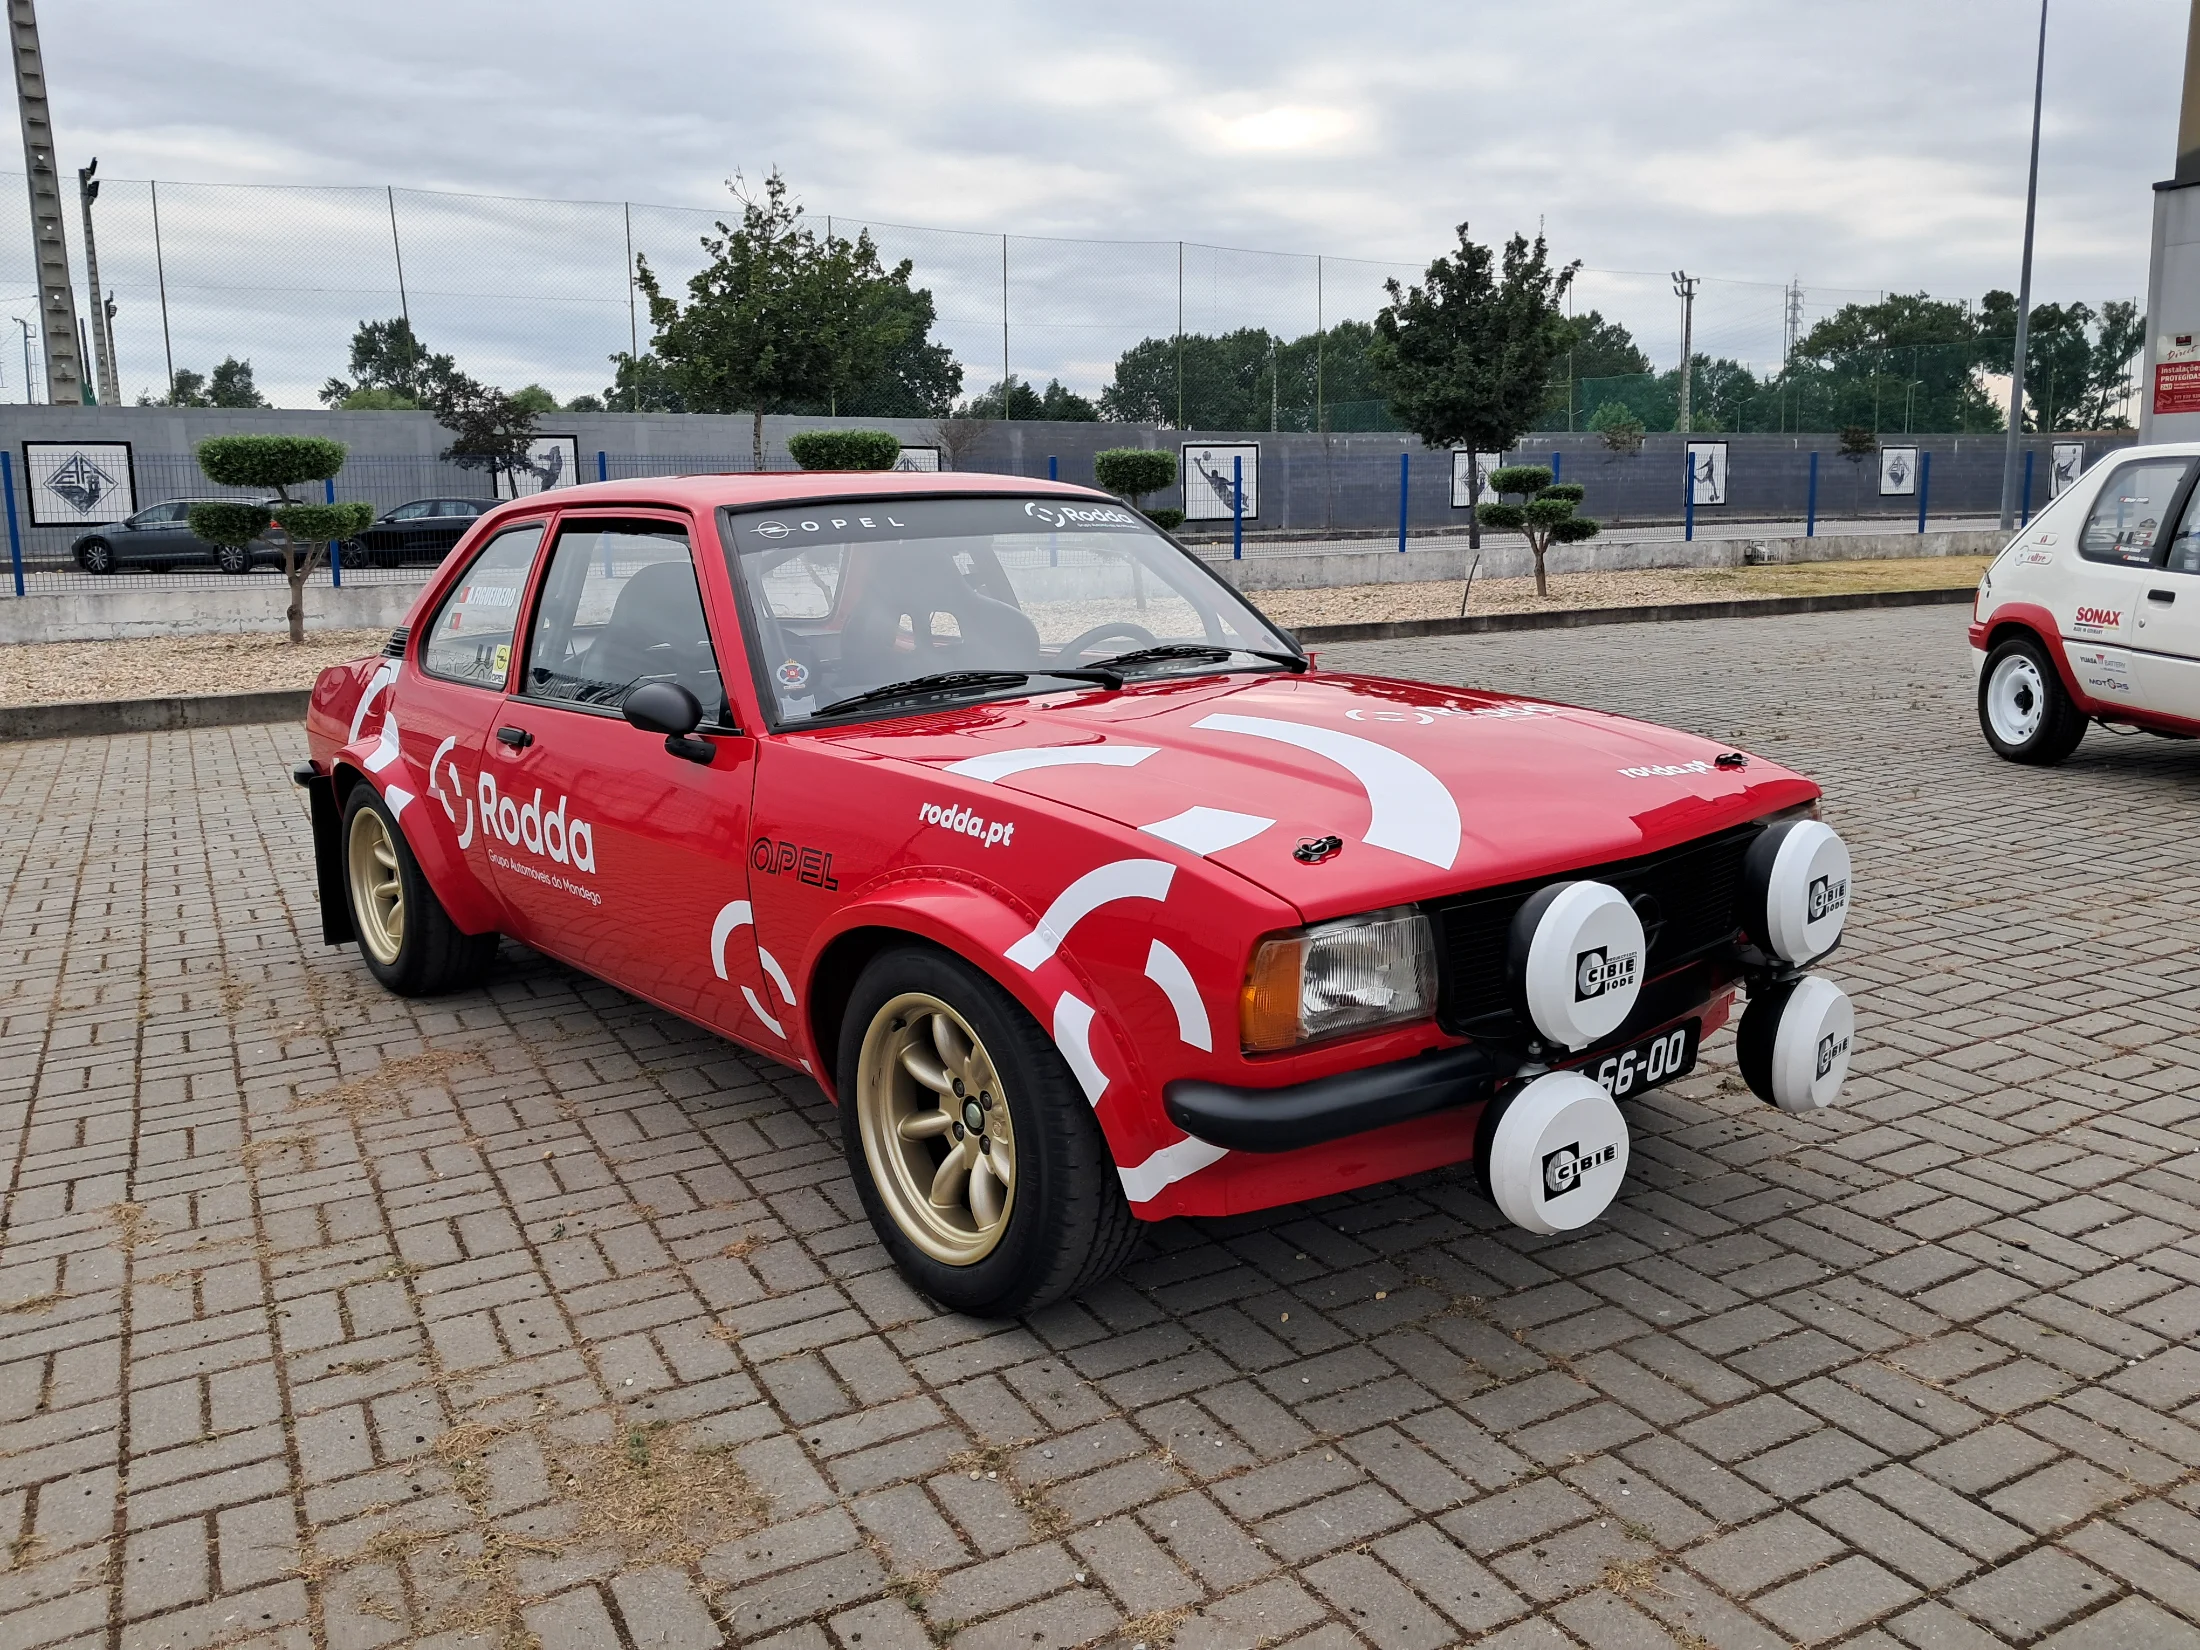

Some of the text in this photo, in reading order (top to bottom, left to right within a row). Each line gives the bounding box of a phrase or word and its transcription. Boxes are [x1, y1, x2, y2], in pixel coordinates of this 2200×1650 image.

[800, 516, 905, 532] OPEL
[1060, 507, 1134, 524] Rodda
[2076, 607, 2121, 626] SONAX
[2080, 656, 2097, 664] YUASA
[478, 771, 596, 874] Rodda
[919, 802, 1014, 848] rodda.pt
[751, 837, 839, 891] OPEL
[488, 848, 602, 906] Grupo Automóveis do Mondego
[1827, 899, 1845, 914] IODE
[1606, 975, 1634, 991] IODE
